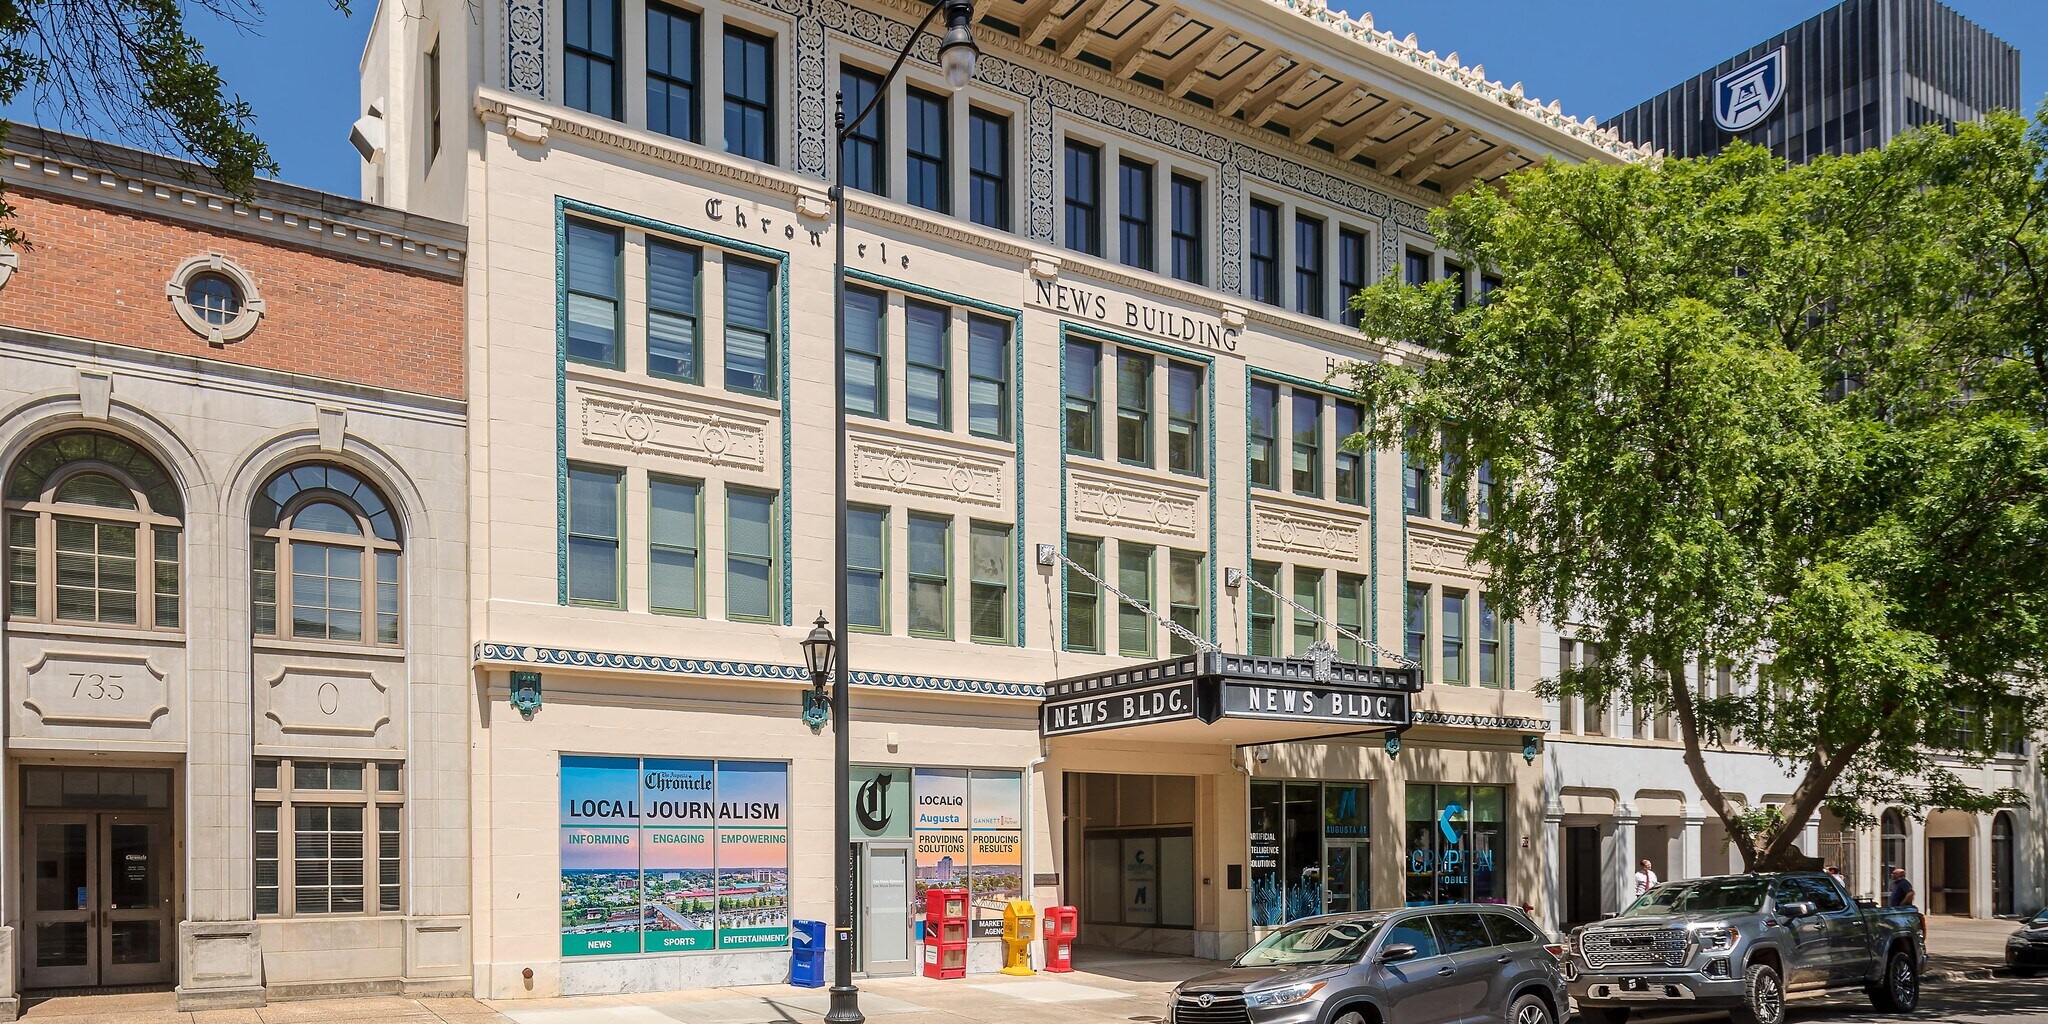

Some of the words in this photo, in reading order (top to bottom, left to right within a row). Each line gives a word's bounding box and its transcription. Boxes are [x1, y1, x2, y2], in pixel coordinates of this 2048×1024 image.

[705, 197, 910, 270] Chroncle
[1035, 279, 1106, 319] NEWS
[1125, 302, 1237, 351] BUILDING
[69, 673, 124, 700] 735
[1249, 687, 1314, 713] NEWS
[1332, 693, 1391, 718] BLDG.
[1054, 700, 1108, 728] NEWS
[1123, 689, 1188, 716] BLDG.
[645, 772, 712, 791] Chronicle
[570, 799, 639, 818] LOCAL
[646, 801, 779, 820] JOURNALISM
[919, 813, 960, 824] Augusta
[1326, 825, 1357, 834] AUGUSTA
[568, 834, 630, 845] INFORMING
[653, 834, 705, 844] ENGAGING
[721, 834, 786, 844] EMPOWERING
[919, 835, 964, 844] PROVIDING
[973, 835, 1019, 844] PRODUCING
[1250, 832, 1276, 841] ARTIFICIAL
[918, 844, 965, 853] SOLUTIONS
[979, 844, 1013, 853] RESULTS
[1251, 846, 1280, 854] TELLIGENCE
[1412, 849, 1493, 873] CRYPTON
[984, 928, 1004, 936] AGENC
[663, 937, 695, 946] SPORTS
[723, 934, 785, 943] ENTERTAINMENT
[587, 940, 612, 949] NEWS
